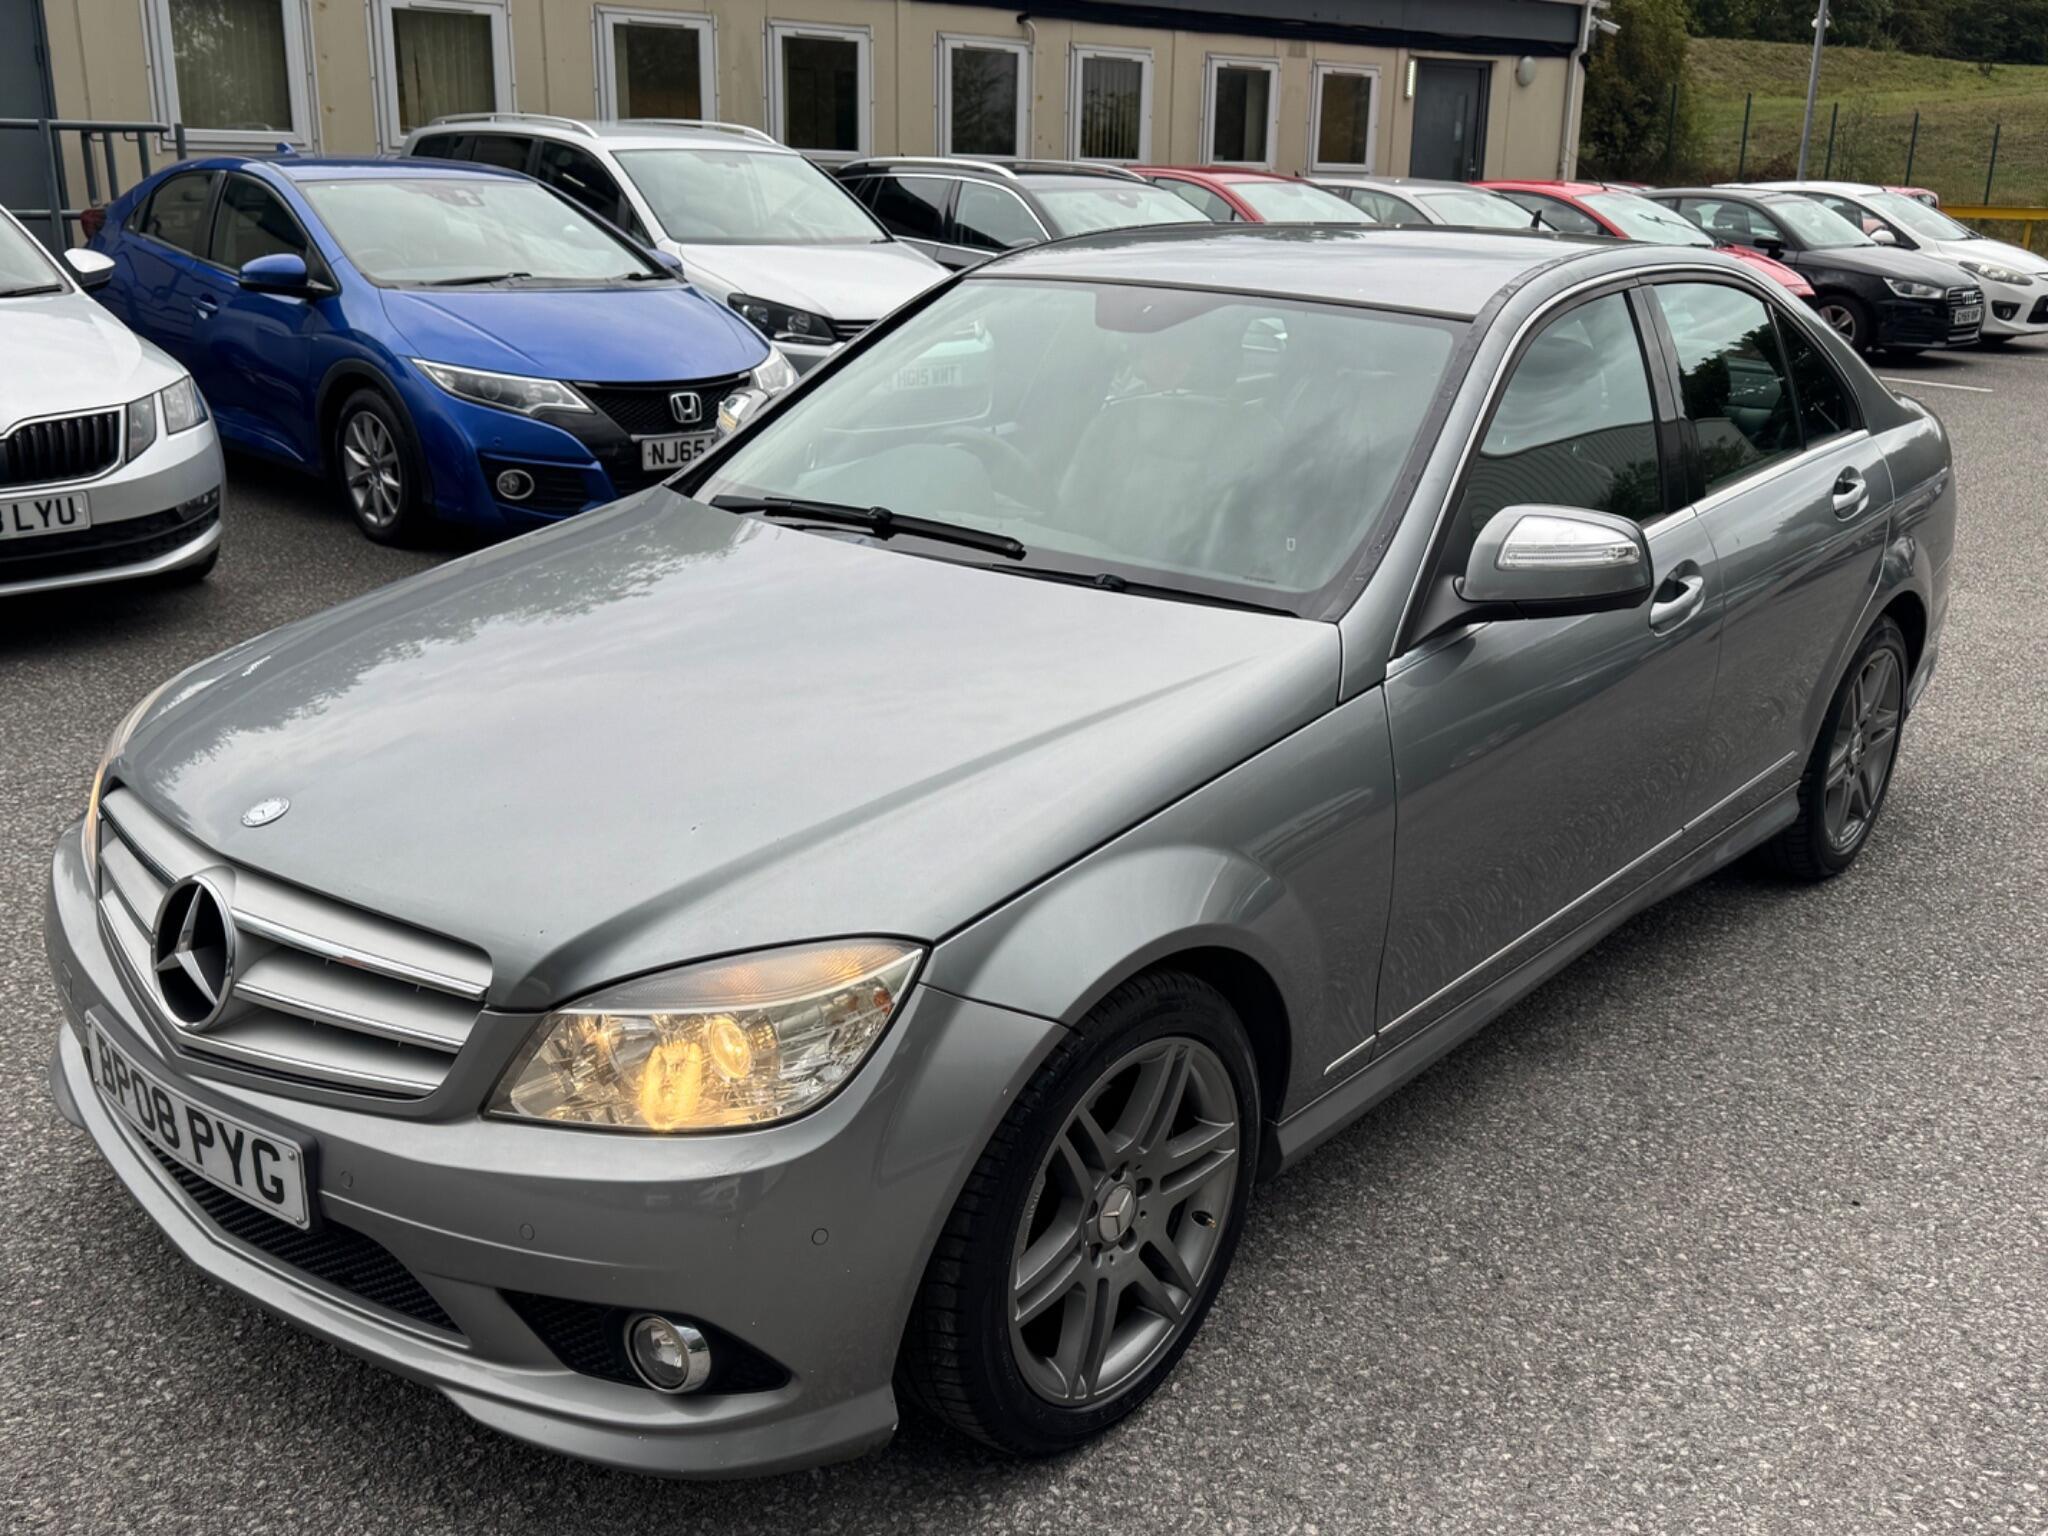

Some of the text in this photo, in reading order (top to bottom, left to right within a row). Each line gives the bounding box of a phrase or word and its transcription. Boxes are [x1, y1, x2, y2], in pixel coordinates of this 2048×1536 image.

[652, 440, 705, 465] NJ65
[12, 497, 76, 532] LYU
[96, 1031, 285, 1205] BP08 PYG
